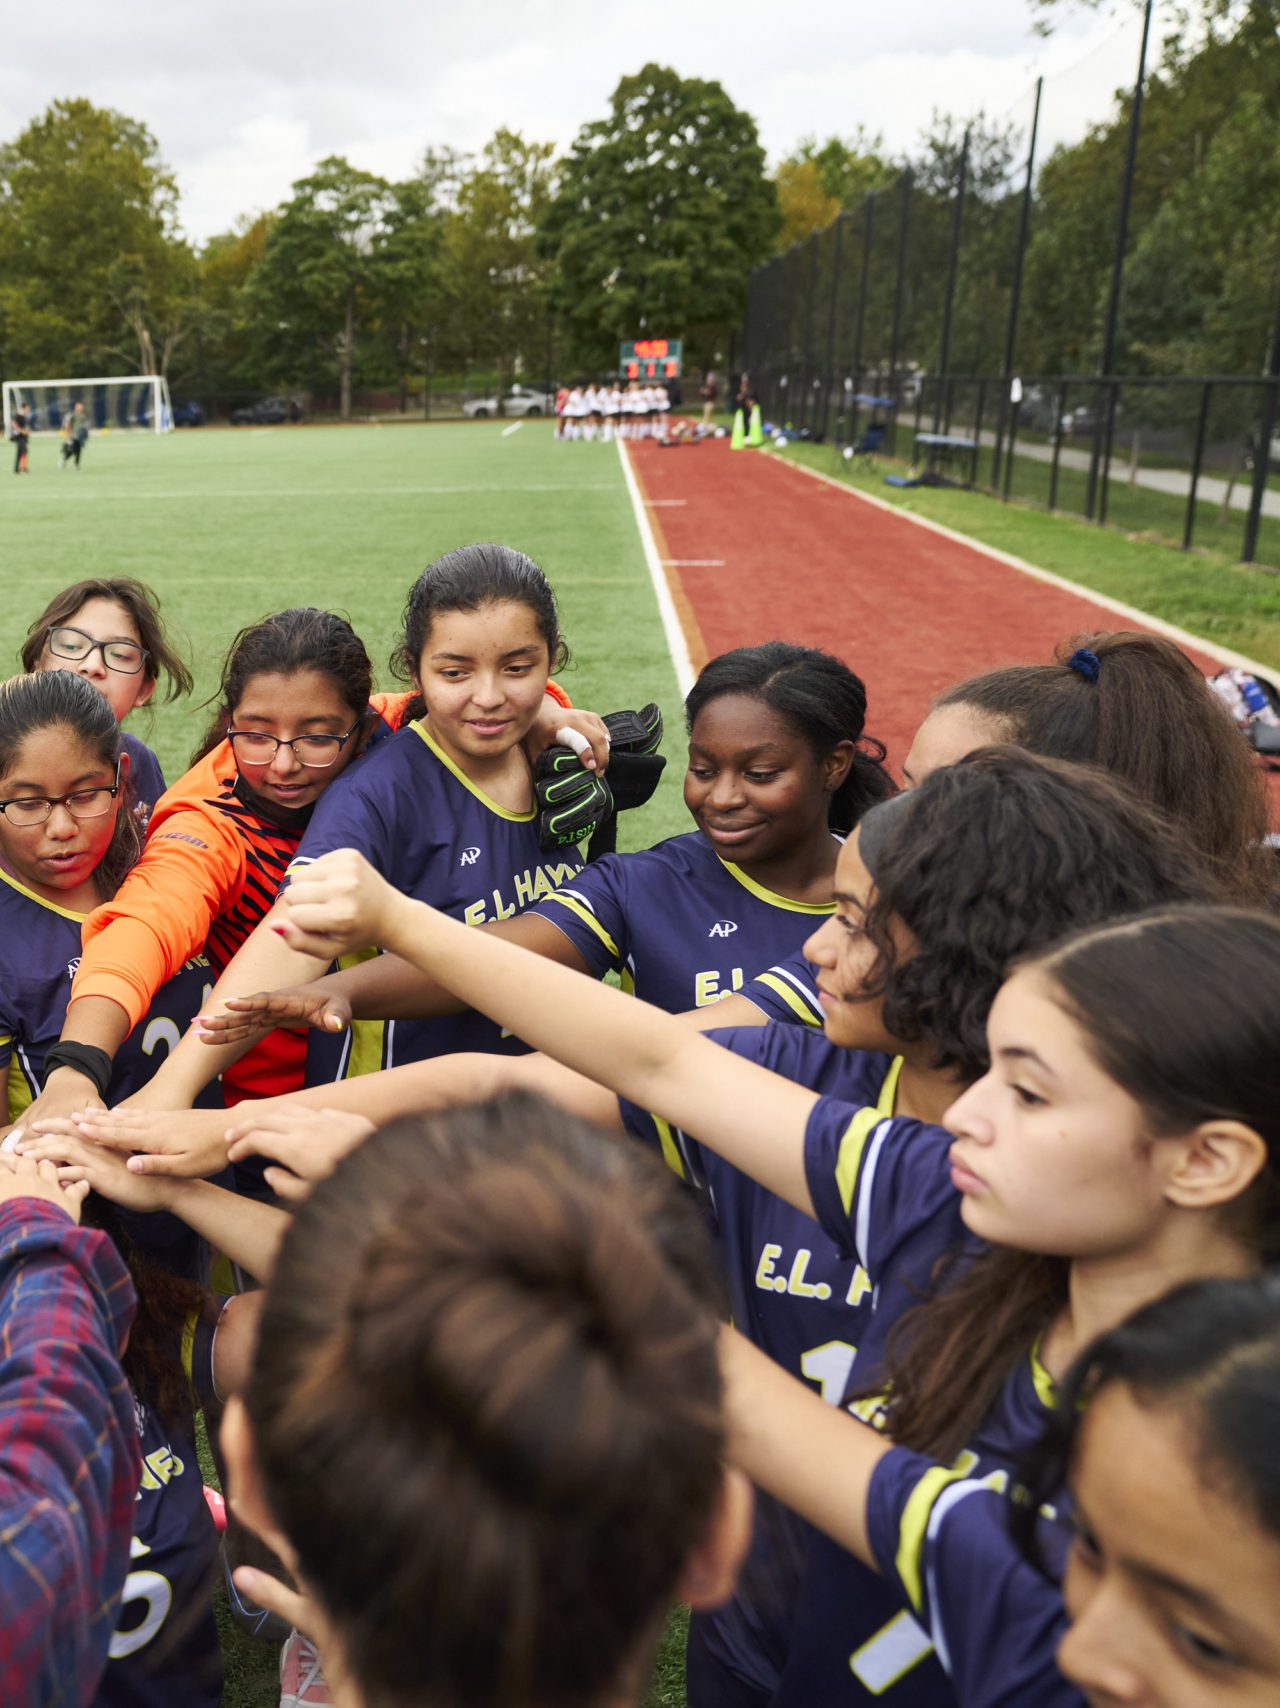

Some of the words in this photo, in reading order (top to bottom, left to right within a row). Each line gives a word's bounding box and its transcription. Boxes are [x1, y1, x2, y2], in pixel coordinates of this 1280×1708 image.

[460, 846, 481, 867] AP
[708, 919, 738, 938] AP
[755, 1242, 832, 1301] E.L.
